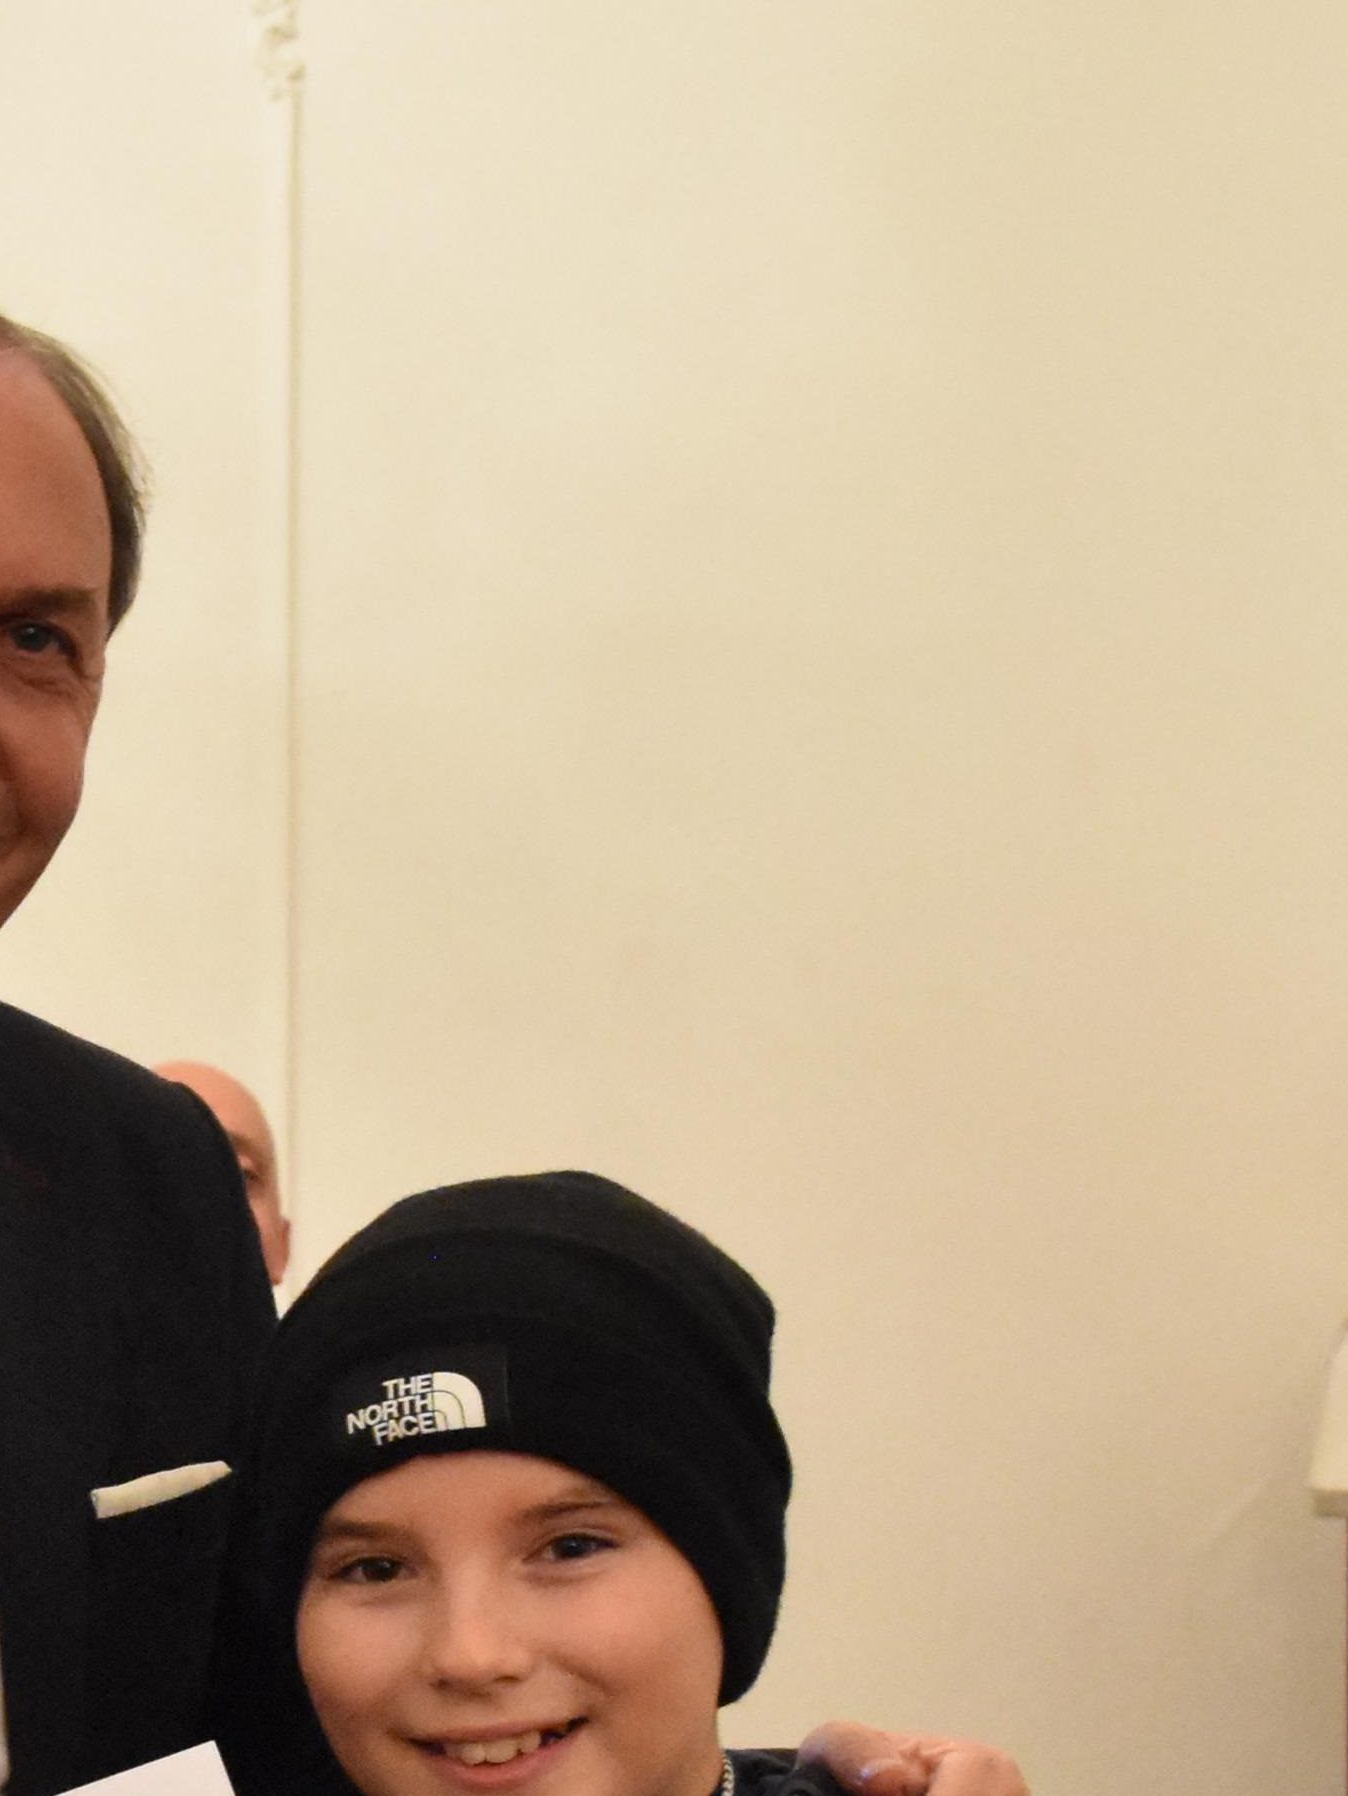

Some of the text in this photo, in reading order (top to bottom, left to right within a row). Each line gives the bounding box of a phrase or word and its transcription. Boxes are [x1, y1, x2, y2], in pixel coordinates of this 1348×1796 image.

[382, 1373, 433, 1400] THE
[346, 1393, 433, 1434] NORTH
[373, 1412, 437, 1446] FACE
